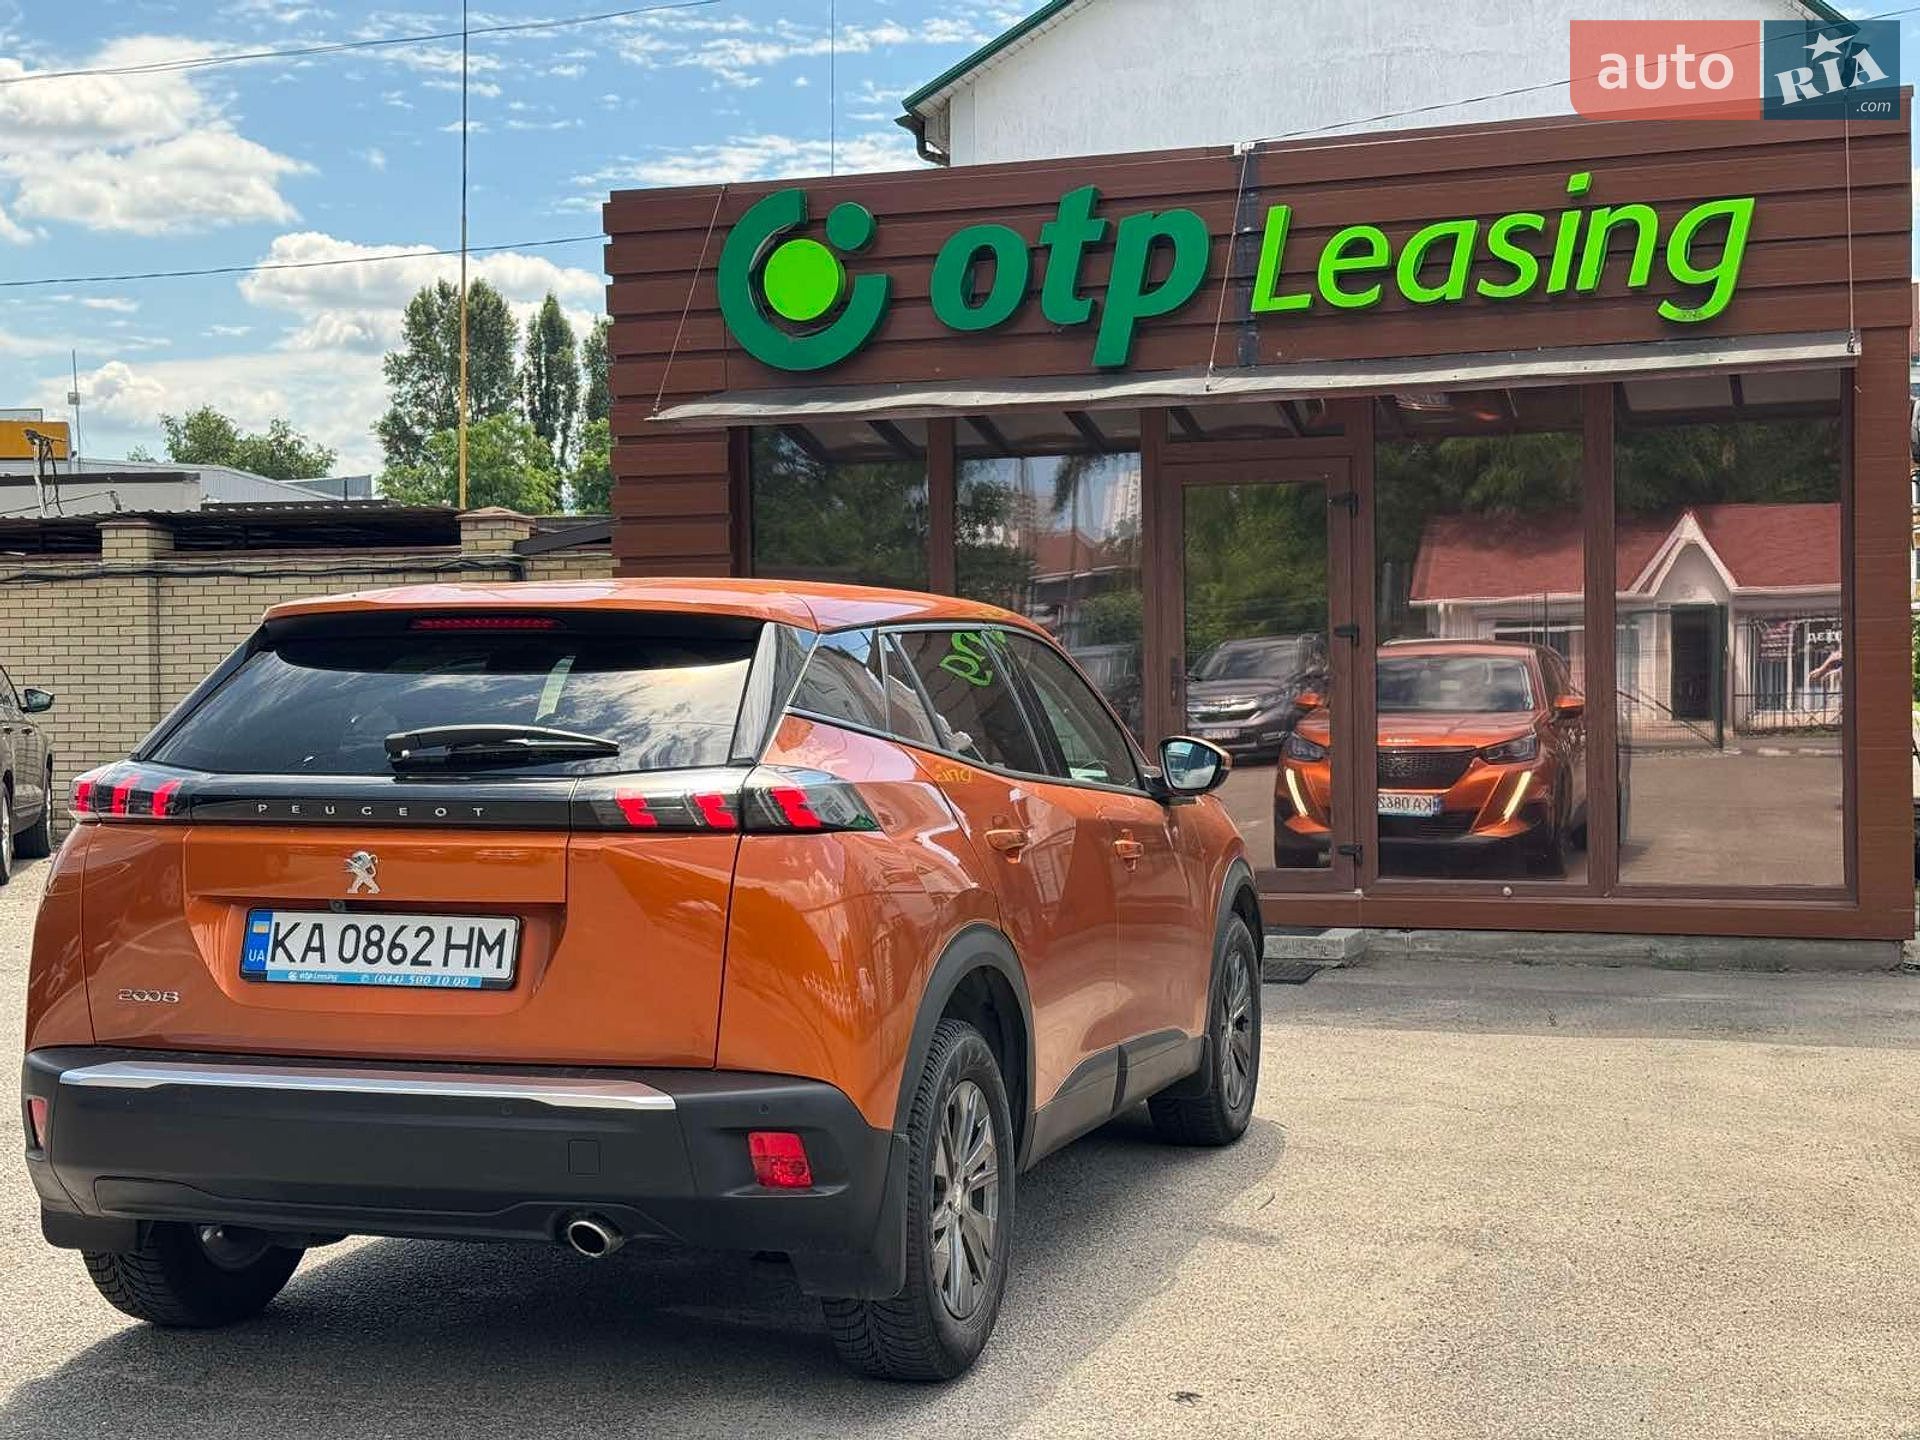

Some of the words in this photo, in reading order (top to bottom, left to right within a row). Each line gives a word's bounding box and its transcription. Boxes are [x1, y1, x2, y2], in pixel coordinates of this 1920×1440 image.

[930, 184, 1212, 368] otp
[1250, 171, 1756, 323] Leasing
[258, 804, 484, 817] PEUGEOT
[338, 924, 436, 967] 0862
[248, 949, 265, 962] UA
[118, 988, 180, 1003] 2008
